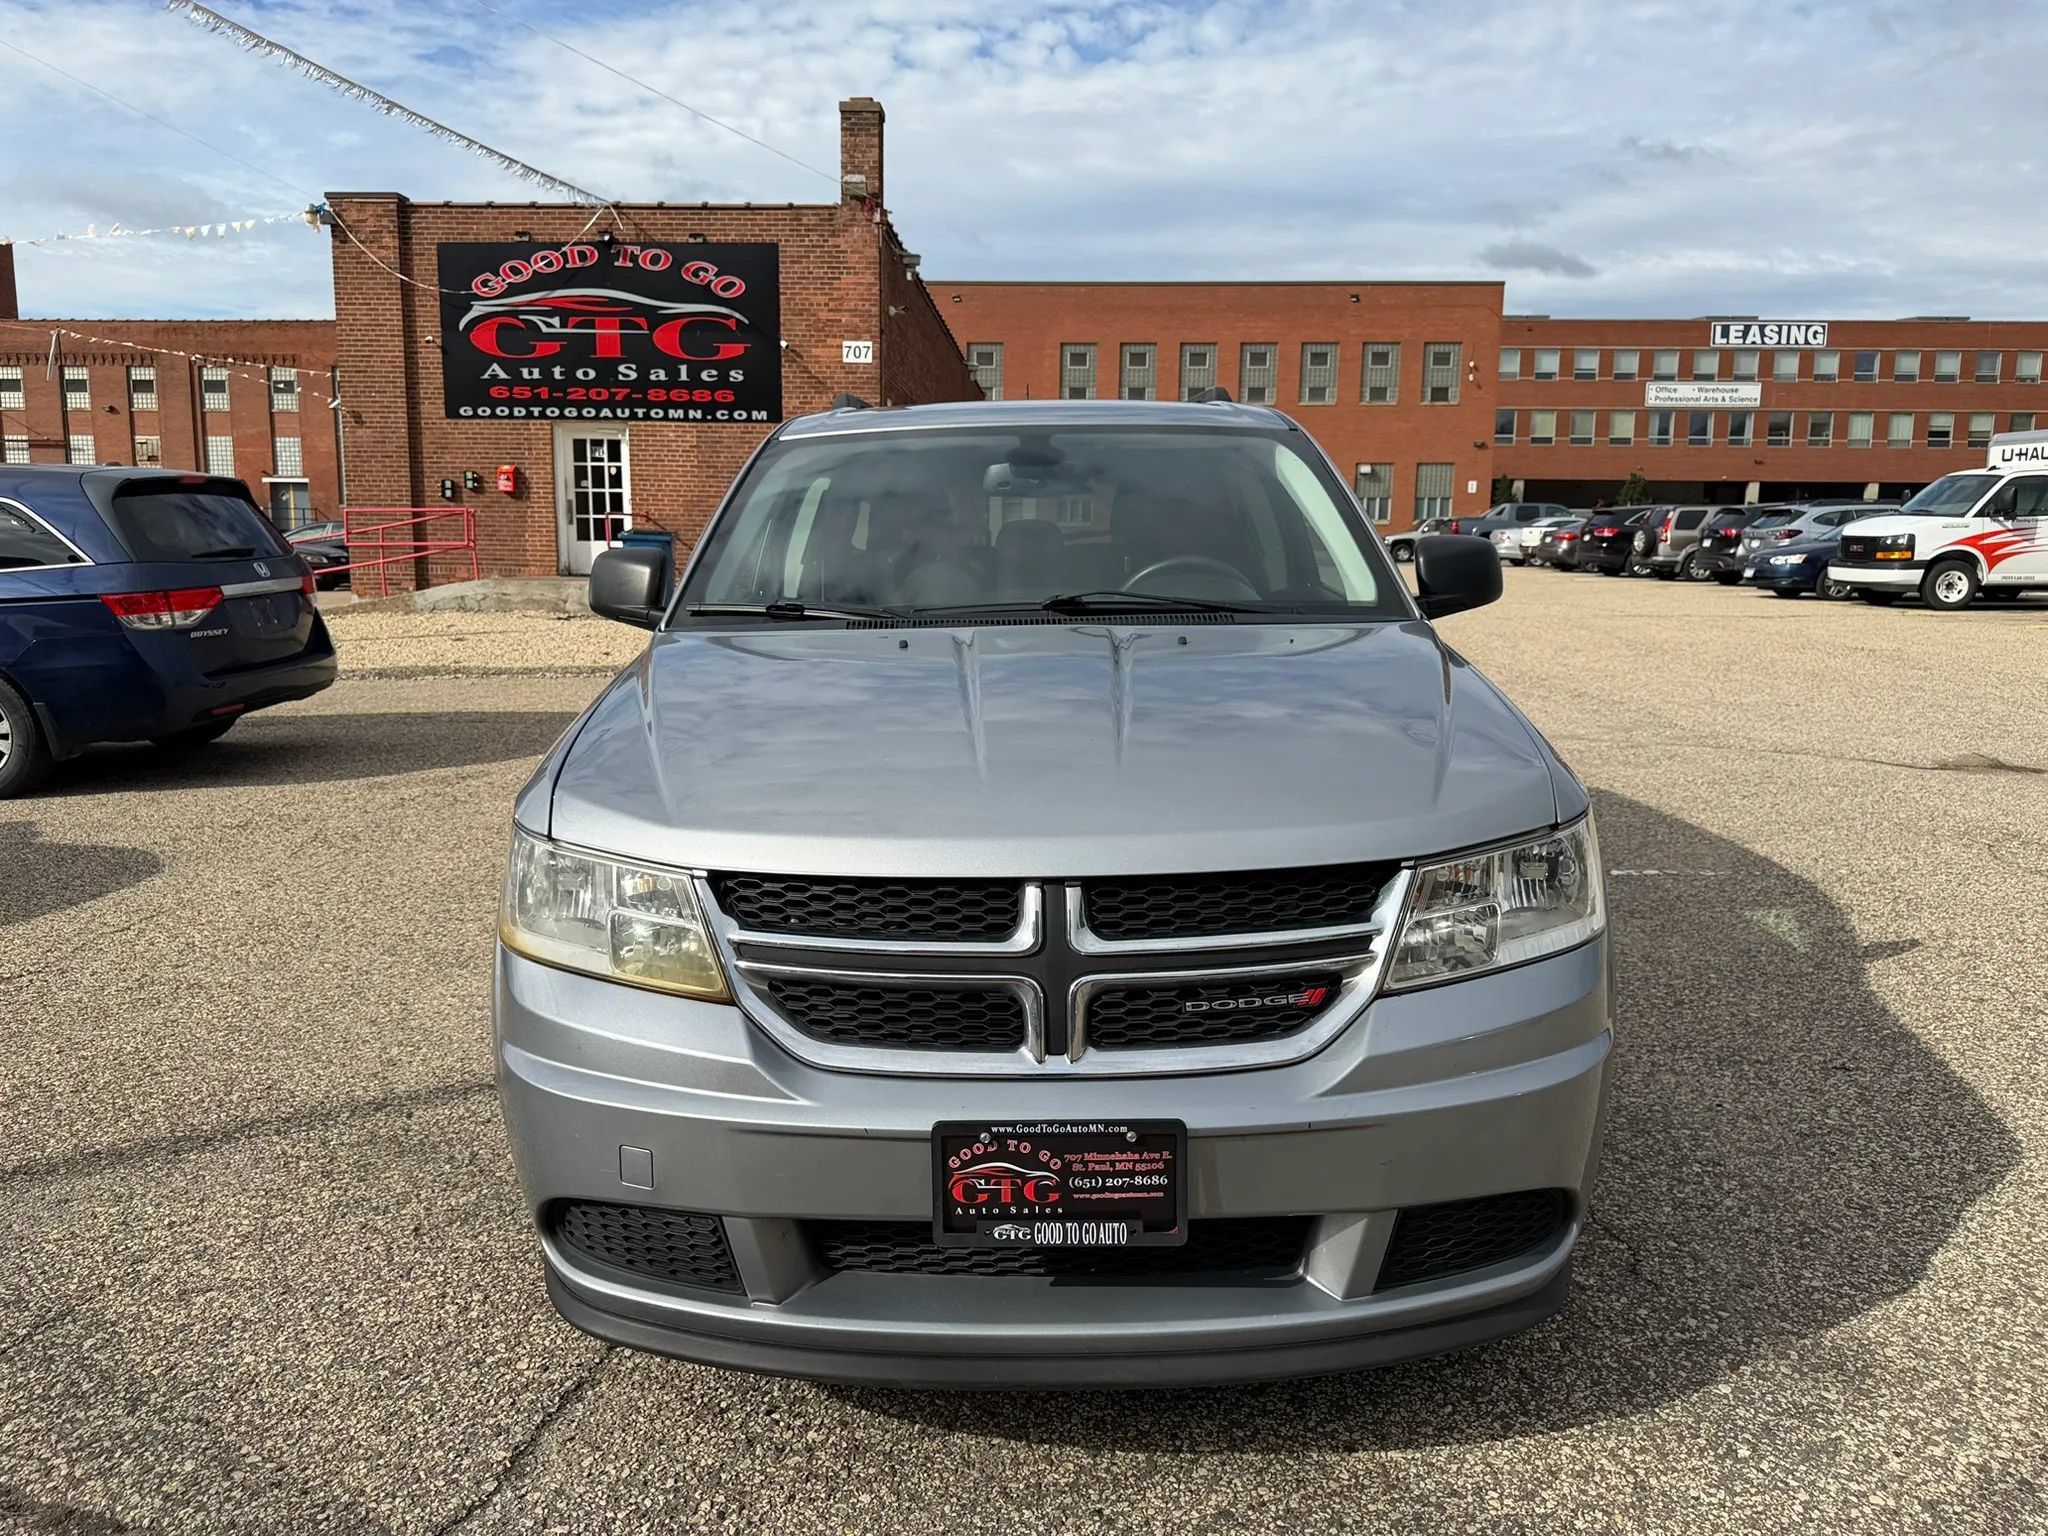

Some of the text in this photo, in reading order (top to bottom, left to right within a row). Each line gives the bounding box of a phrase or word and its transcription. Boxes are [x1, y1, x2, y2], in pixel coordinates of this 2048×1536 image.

[471, 245, 747, 298] GOOD TO GO
[469, 315, 752, 360] GTG
[1714, 325, 1825, 345] LEASING
[844, 345, 871, 359] 707
[480, 363, 745, 383] Auto Sales
[489, 385, 736, 403] 651-207-8686
[1655, 386, 1739, 394] Office Warehouse
[1654, 395, 1758, 404] Professional Arts & Science
[459, 406, 768, 422] GOODTOGOAUTOMN.COM
[1185, 992, 1309, 1012] DODGE
[991, 1123, 1128, 1134] www.GoodToGoAutoMN.com
[948, 1139, 1062, 1170] GOOD TO GO
[1064, 1154, 1083, 1162] 707
[1142, 1151, 1161, 1160] Ave
[1072, 1161, 1165, 1171] St. Paul, MN 55106
[1068, 1175, 1168, 1188] (651) 207-8686
[951, 1178, 1062, 1204] GTG
[955, 1205, 1064, 1215] Auto Sales
[1034, 1222, 1063, 1245] GOOD
[1065, 1222, 1080, 1245] TO
[1082, 1222, 1097, 1245] GO
[1098, 1222, 1128, 1245] AUTO
